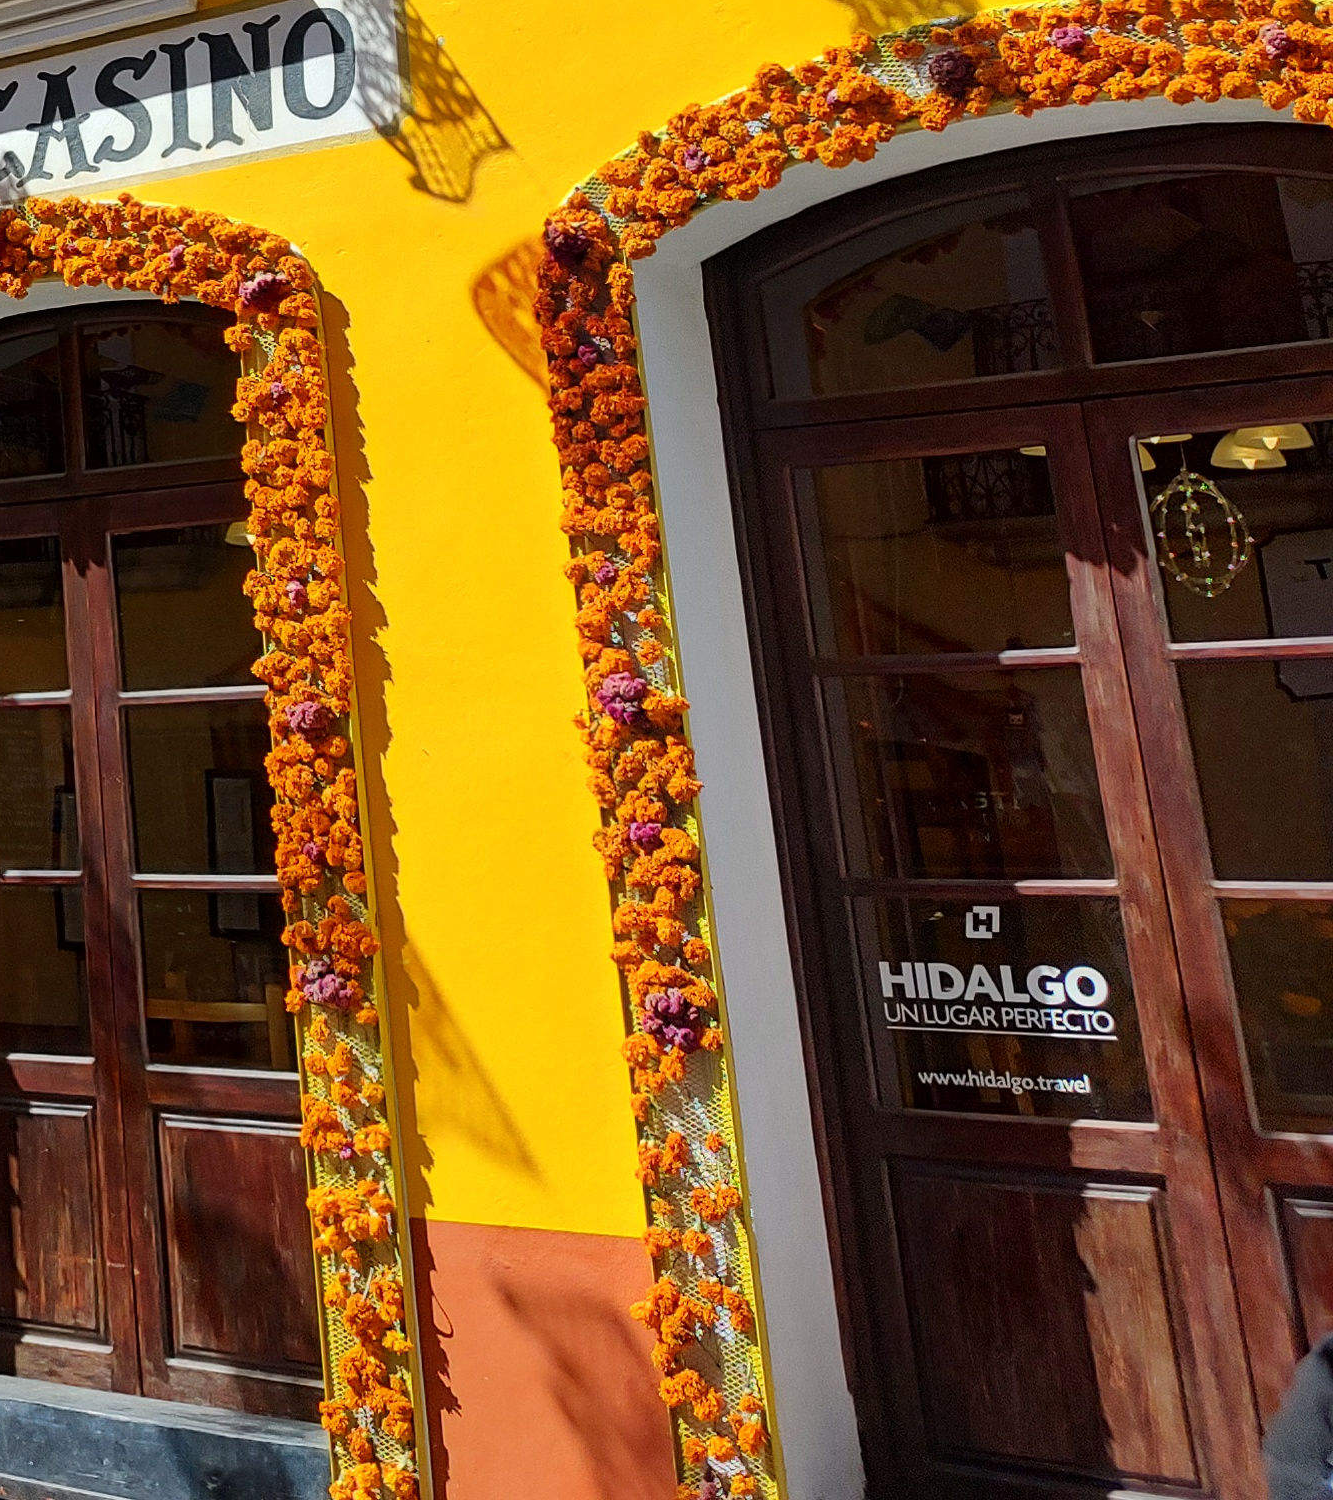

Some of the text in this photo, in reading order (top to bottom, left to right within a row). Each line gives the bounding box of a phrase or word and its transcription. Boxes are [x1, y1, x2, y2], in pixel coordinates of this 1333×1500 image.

[878, 961, 1110, 1007] HIDALGO
[883, 1002, 1115, 1034] UN LUGAR PERFECTO
[918, 1068, 1091, 1095] www.hidalgo.travel
